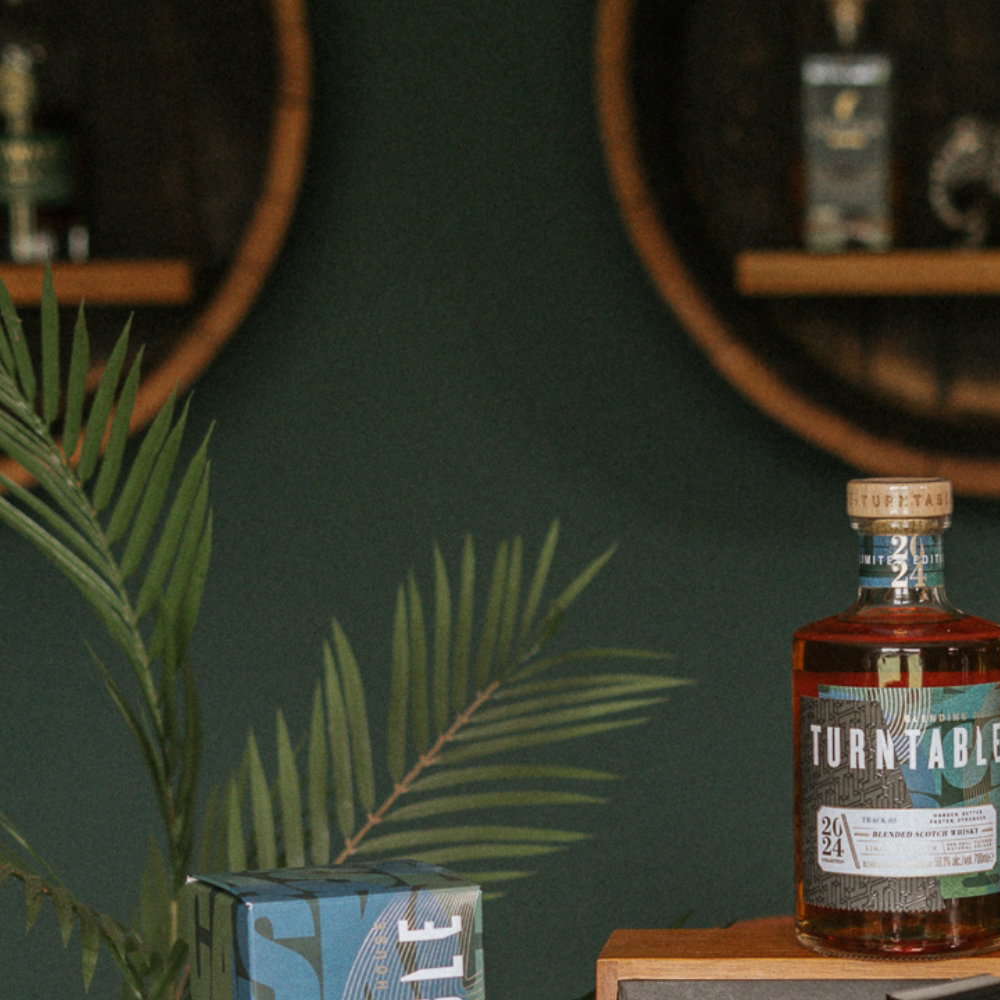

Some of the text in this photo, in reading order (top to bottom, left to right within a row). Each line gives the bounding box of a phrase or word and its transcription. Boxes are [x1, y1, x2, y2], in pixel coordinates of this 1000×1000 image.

[821, 816, 843, 837] 20
[872, 828, 979, 839] BLENDED SCOTCH WHISKY
[822, 837, 845, 858] 24
[374, 920, 388, 991] HOUSE
